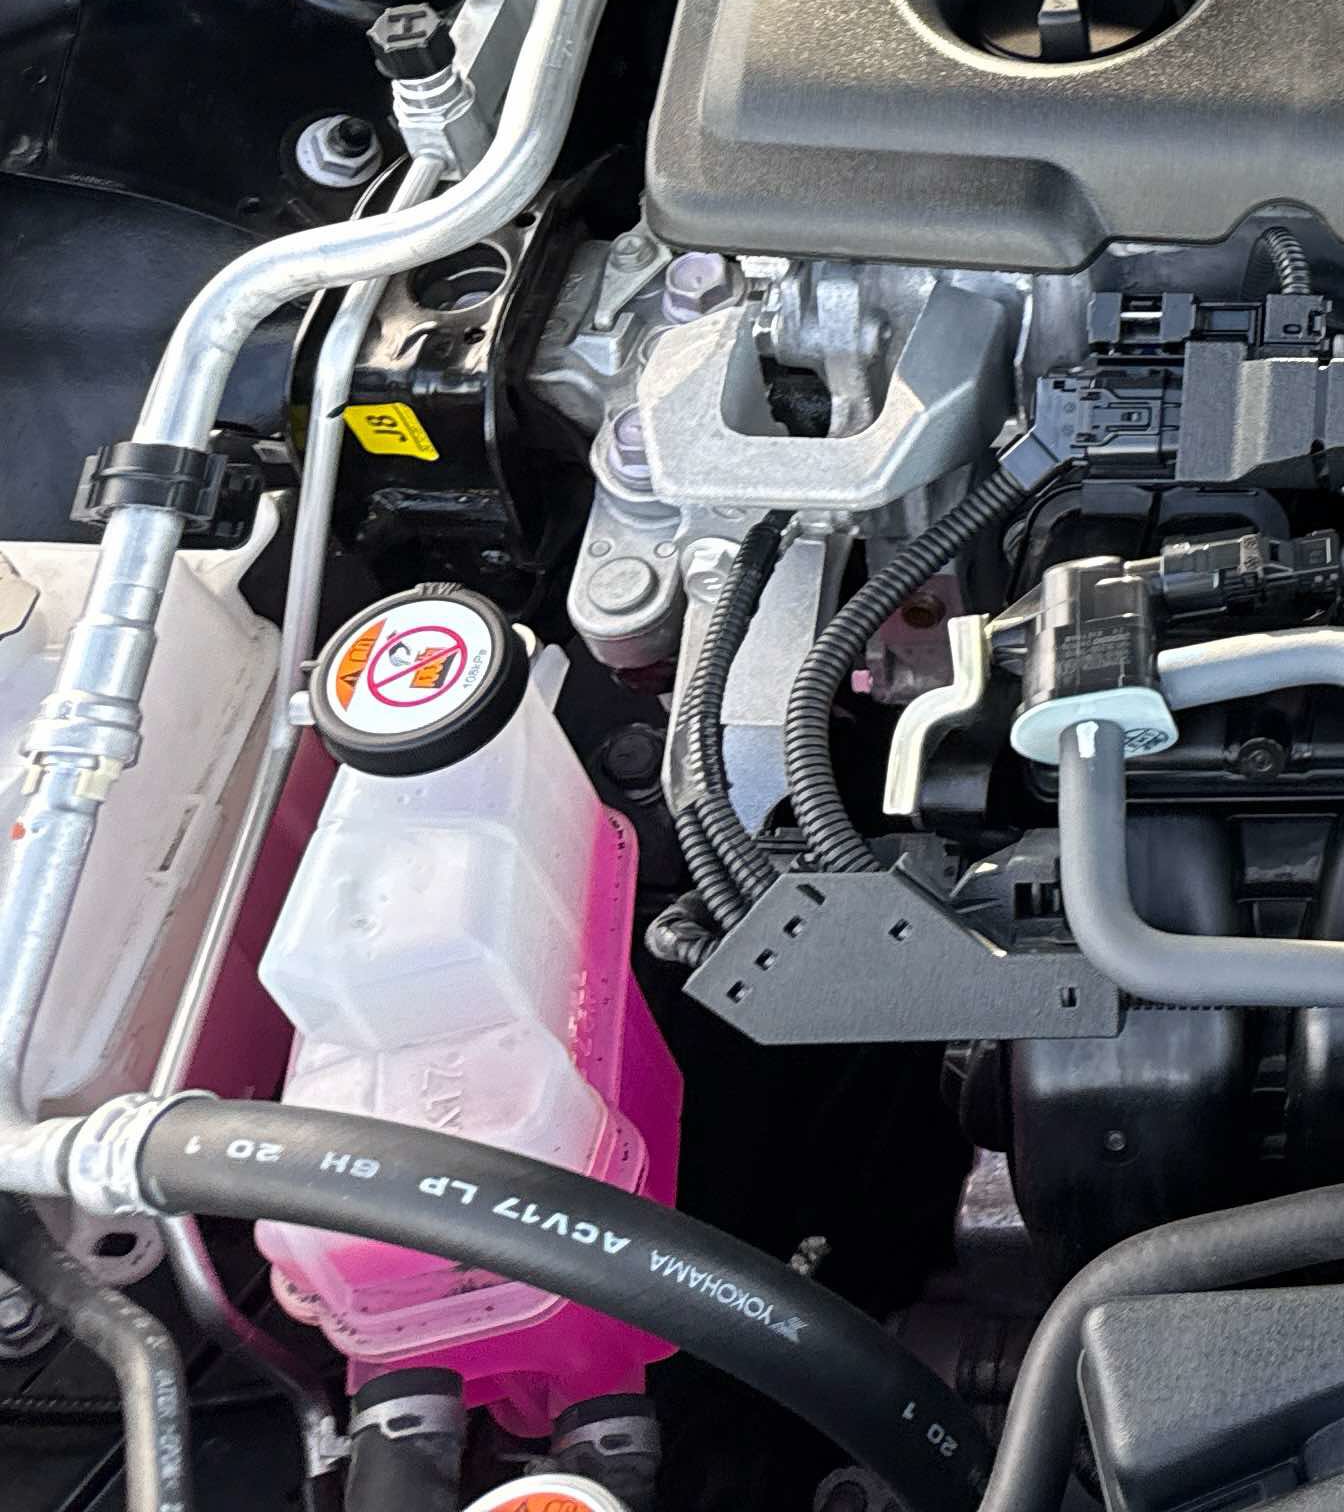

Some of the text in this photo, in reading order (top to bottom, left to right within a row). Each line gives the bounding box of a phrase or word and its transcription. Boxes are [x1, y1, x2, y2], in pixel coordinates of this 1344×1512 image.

[386, 10, 428, 43] H
[418, 1176, 480, 1205] LP
[492, 1197, 632, 1255] ACV17
[650, 1249, 776, 1325] YOKOHAMA
